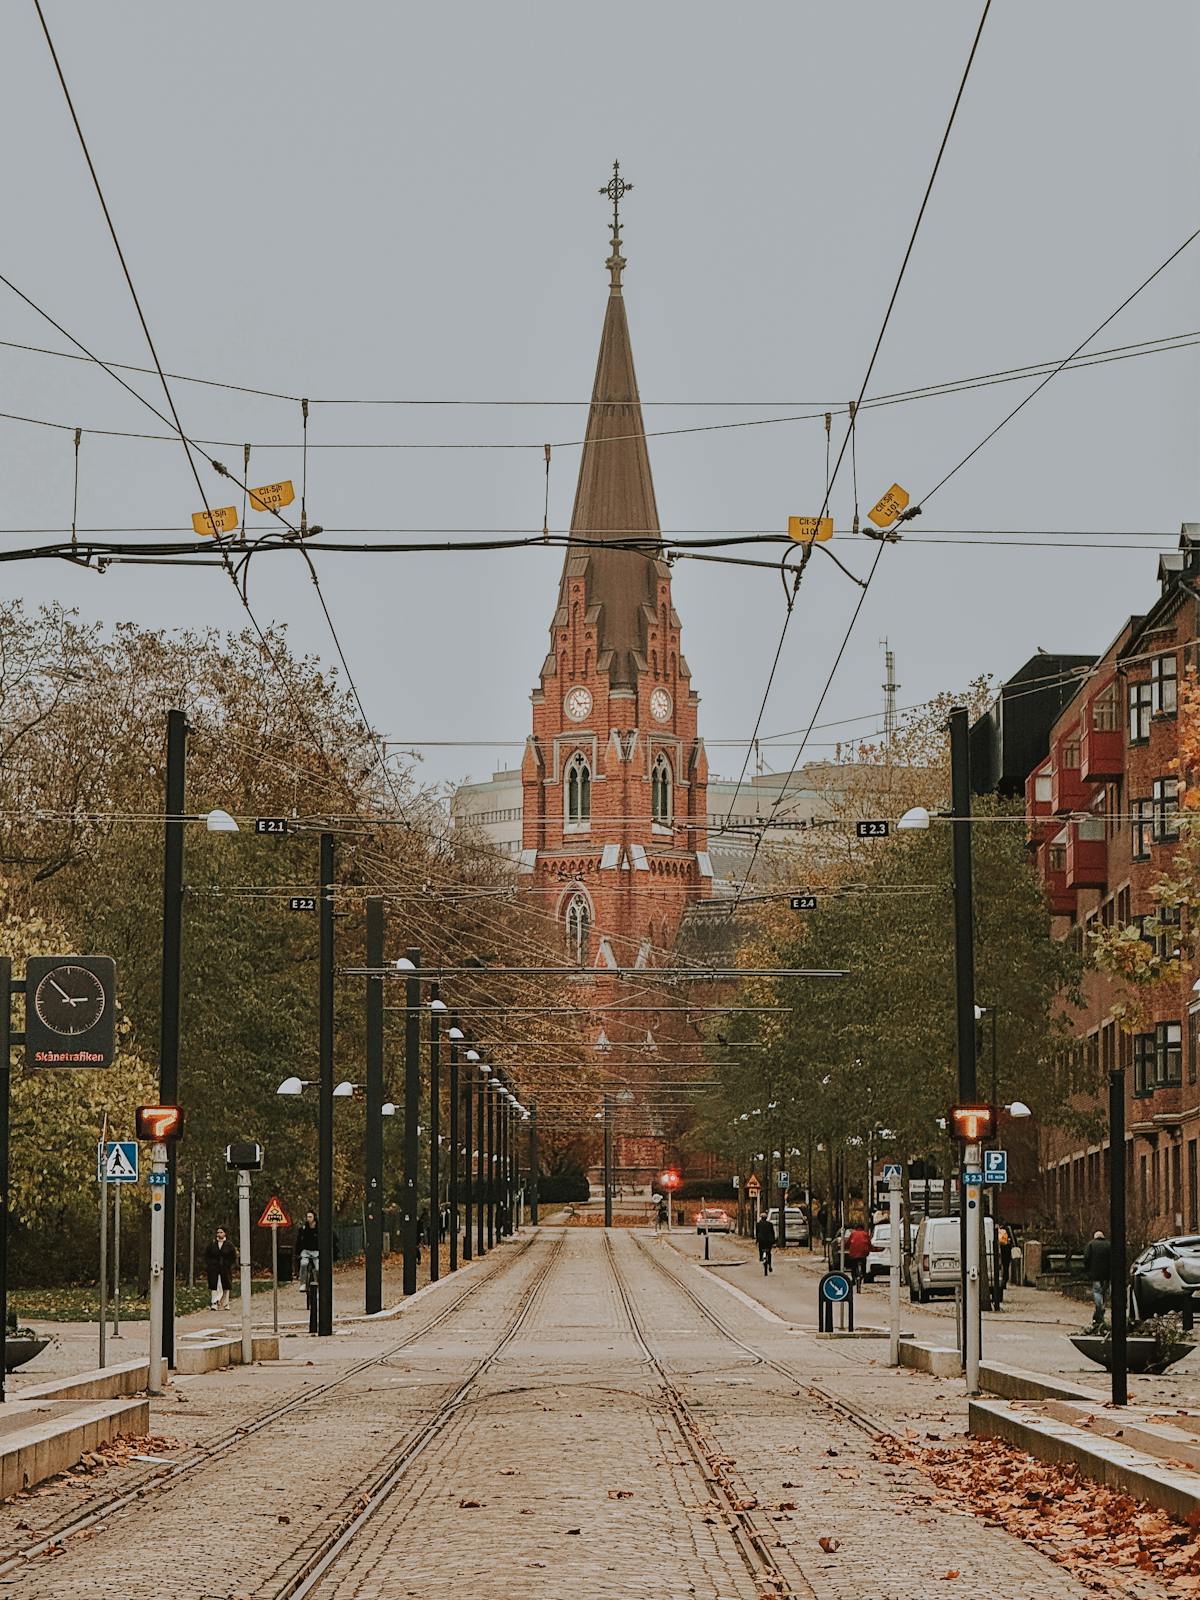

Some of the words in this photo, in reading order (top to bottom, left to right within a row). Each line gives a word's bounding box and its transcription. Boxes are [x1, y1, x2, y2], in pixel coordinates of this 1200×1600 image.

[206, 520, 225, 529] L01
[258, 821, 266, 832] E
[268, 821, 284, 832] 2.1
[860, 824, 867, 834] E
[869, 824, 886, 834] 2.3
[292, 900, 298, 909] E
[299, 900, 314, 909] 2.2
[793, 899, 799, 908] E
[800, 899, 815, 908] 2.4
[35, 1050, 104, 1062] Skånetrafiken
[990, 1153, 1003, 1170] P
[149, 1175, 155, 1183] S
